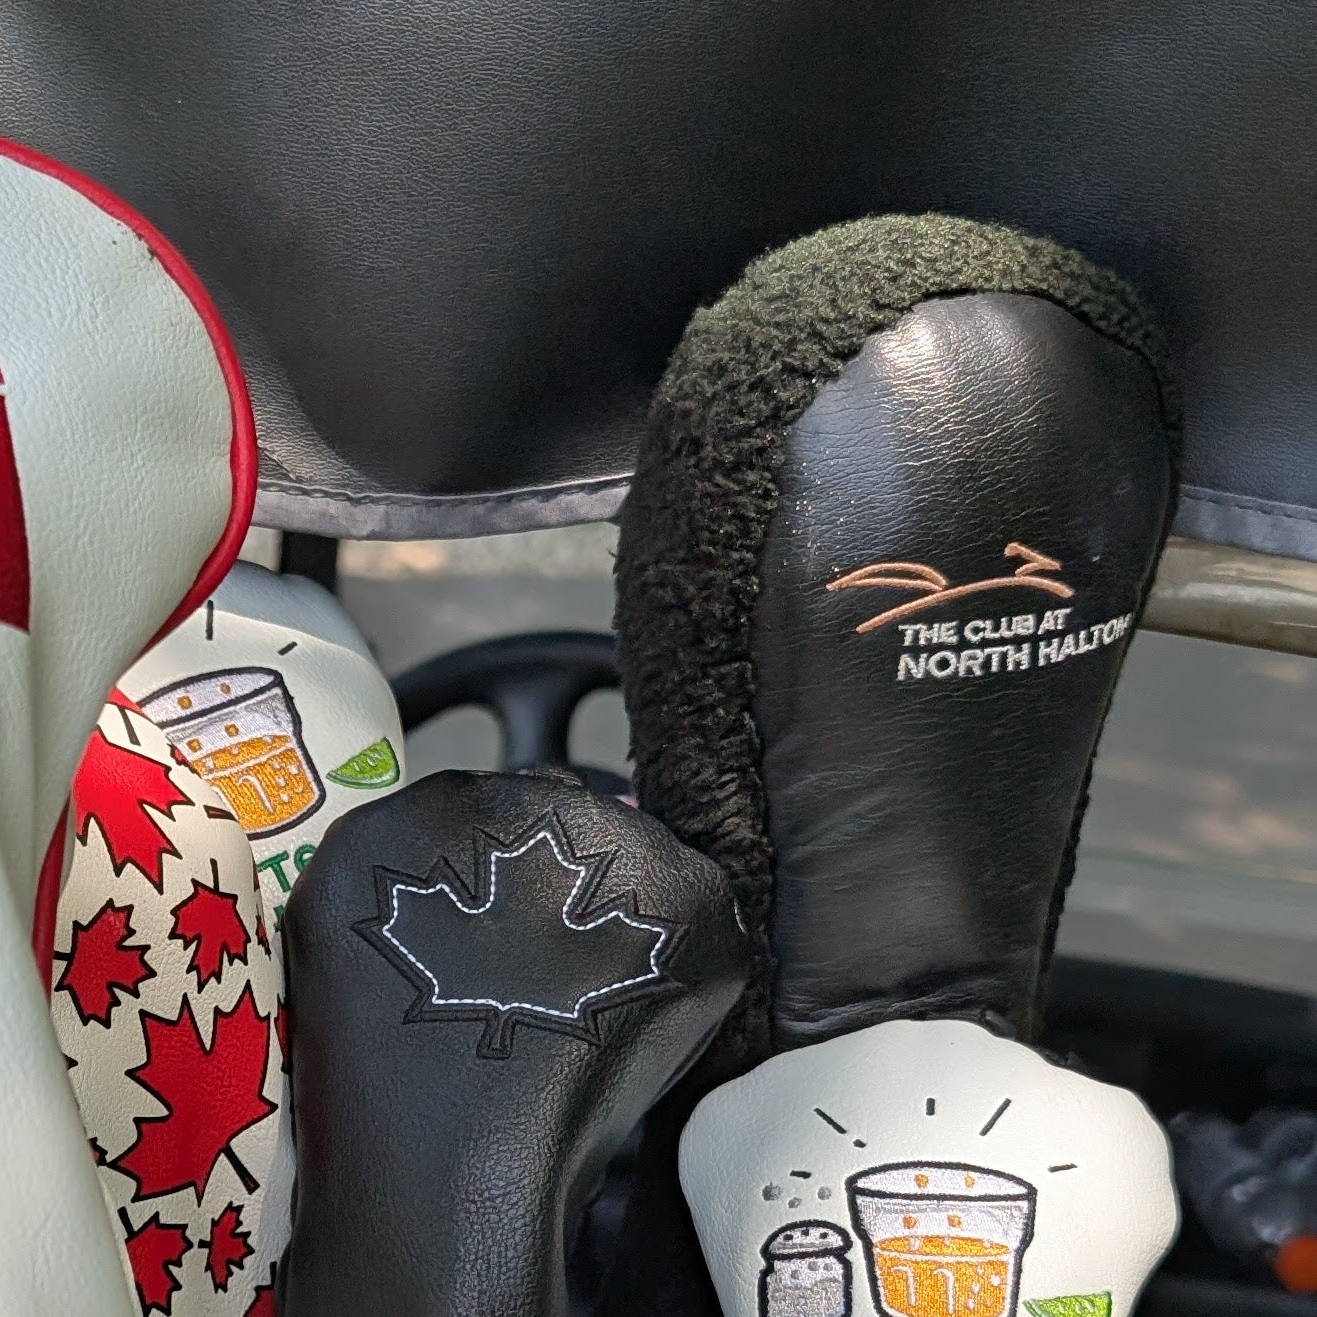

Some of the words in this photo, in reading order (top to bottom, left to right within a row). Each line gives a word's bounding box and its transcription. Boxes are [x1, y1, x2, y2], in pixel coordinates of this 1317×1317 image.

[896, 643, 1033, 681] NORTH
[1038, 612, 1135, 667] HALTON
[898, 620, 960, 646] THE
[963, 613, 1036, 643] CLUB
[1038, 607, 1074, 635] AT
